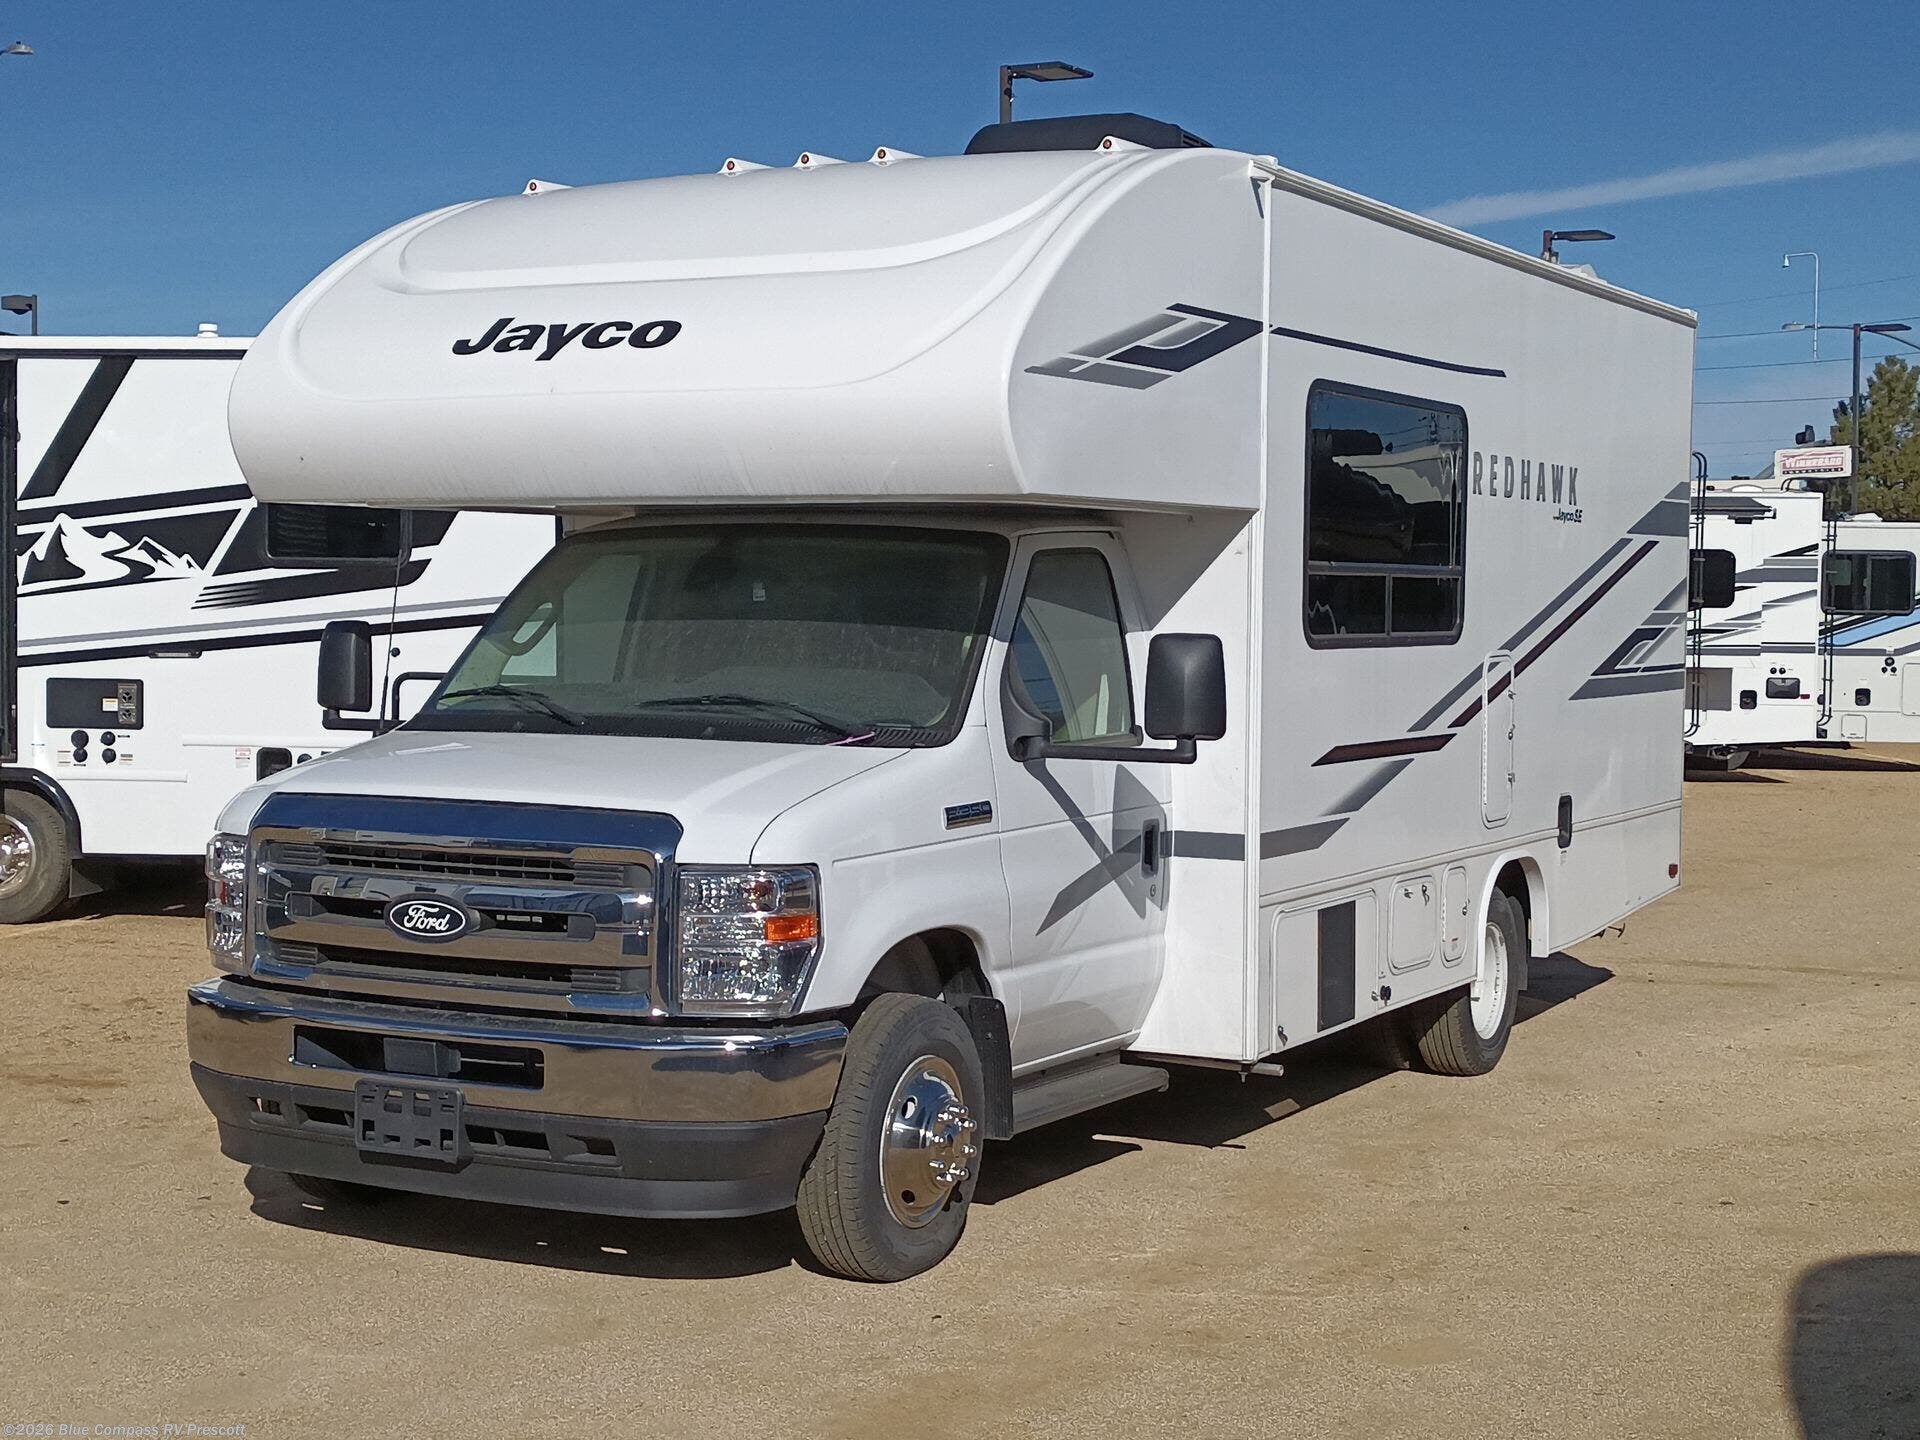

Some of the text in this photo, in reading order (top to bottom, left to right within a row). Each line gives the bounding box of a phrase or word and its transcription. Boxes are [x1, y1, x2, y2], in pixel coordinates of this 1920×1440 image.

[452, 317, 682, 361] Jayco
[1472, 451, 1578, 506] REDHAWK
[403, 904, 450, 931] Ford
